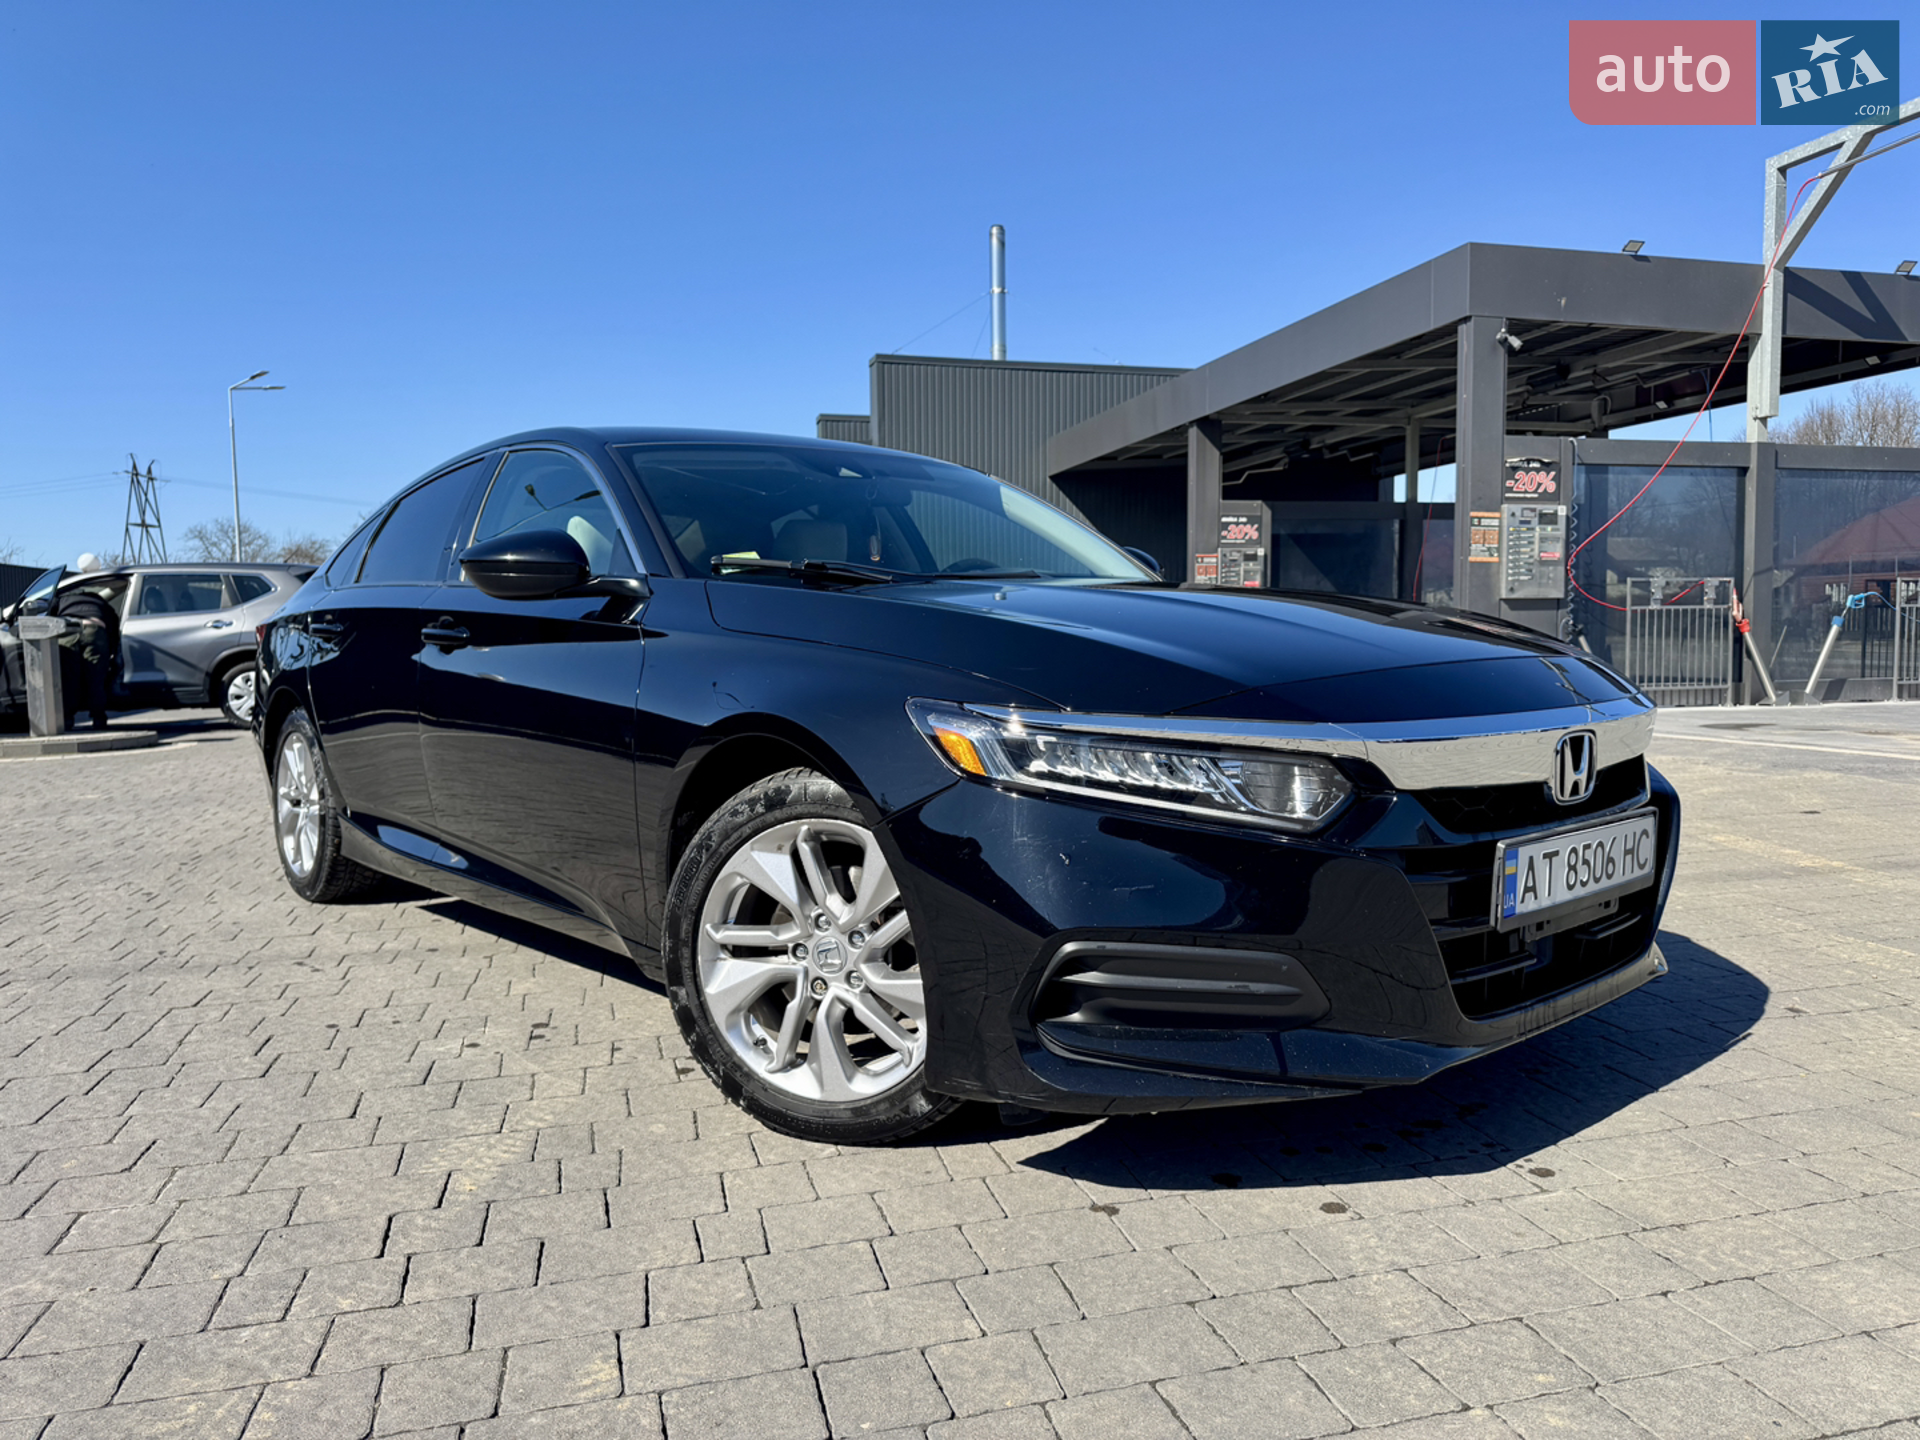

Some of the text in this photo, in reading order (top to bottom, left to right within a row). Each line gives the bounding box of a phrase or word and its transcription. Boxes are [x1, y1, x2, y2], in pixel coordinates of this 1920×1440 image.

[1505, 471, 1556, 493] -20%
[1221, 524, 1259, 540] -20%
[1519, 828, 1650, 904] AT 8506 HC
